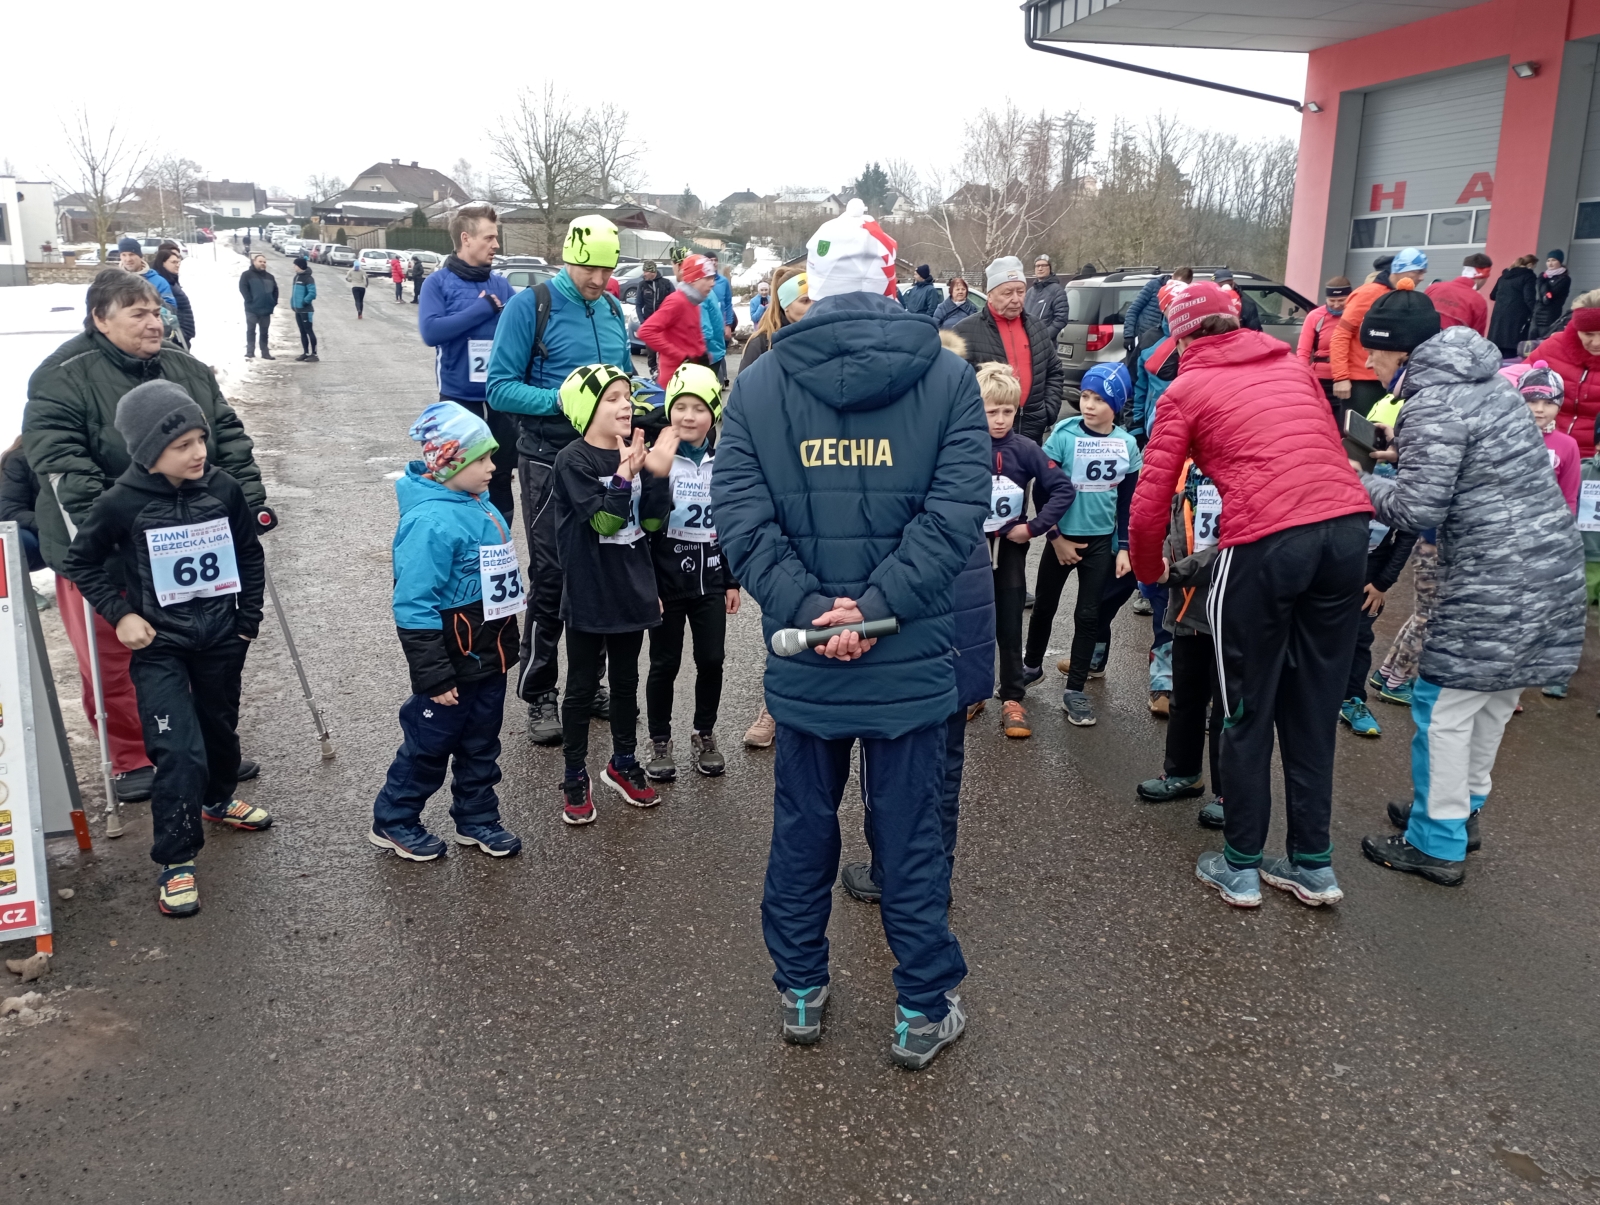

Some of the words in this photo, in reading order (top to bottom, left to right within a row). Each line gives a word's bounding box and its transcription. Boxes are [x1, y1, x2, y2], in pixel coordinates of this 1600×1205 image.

[1369, 181, 1407, 212] H
[1455, 171, 1494, 205] A
[474, 356, 488, 373] 2
[800, 438, 893, 467] CZECHIA
[1086, 460, 1117, 481] 63
[677, 481, 703, 491] ZIMNÍ
[684, 504, 715, 528] 28
[988, 496, 1011, 519] 6
[151, 528, 189, 543] ZIMNÍ
[1199, 512, 1220, 539] 38
[152, 538, 207, 552] BĚŽECKÁ
[208, 532, 230, 544] LIGA
[173, 552, 220, 587] 68
